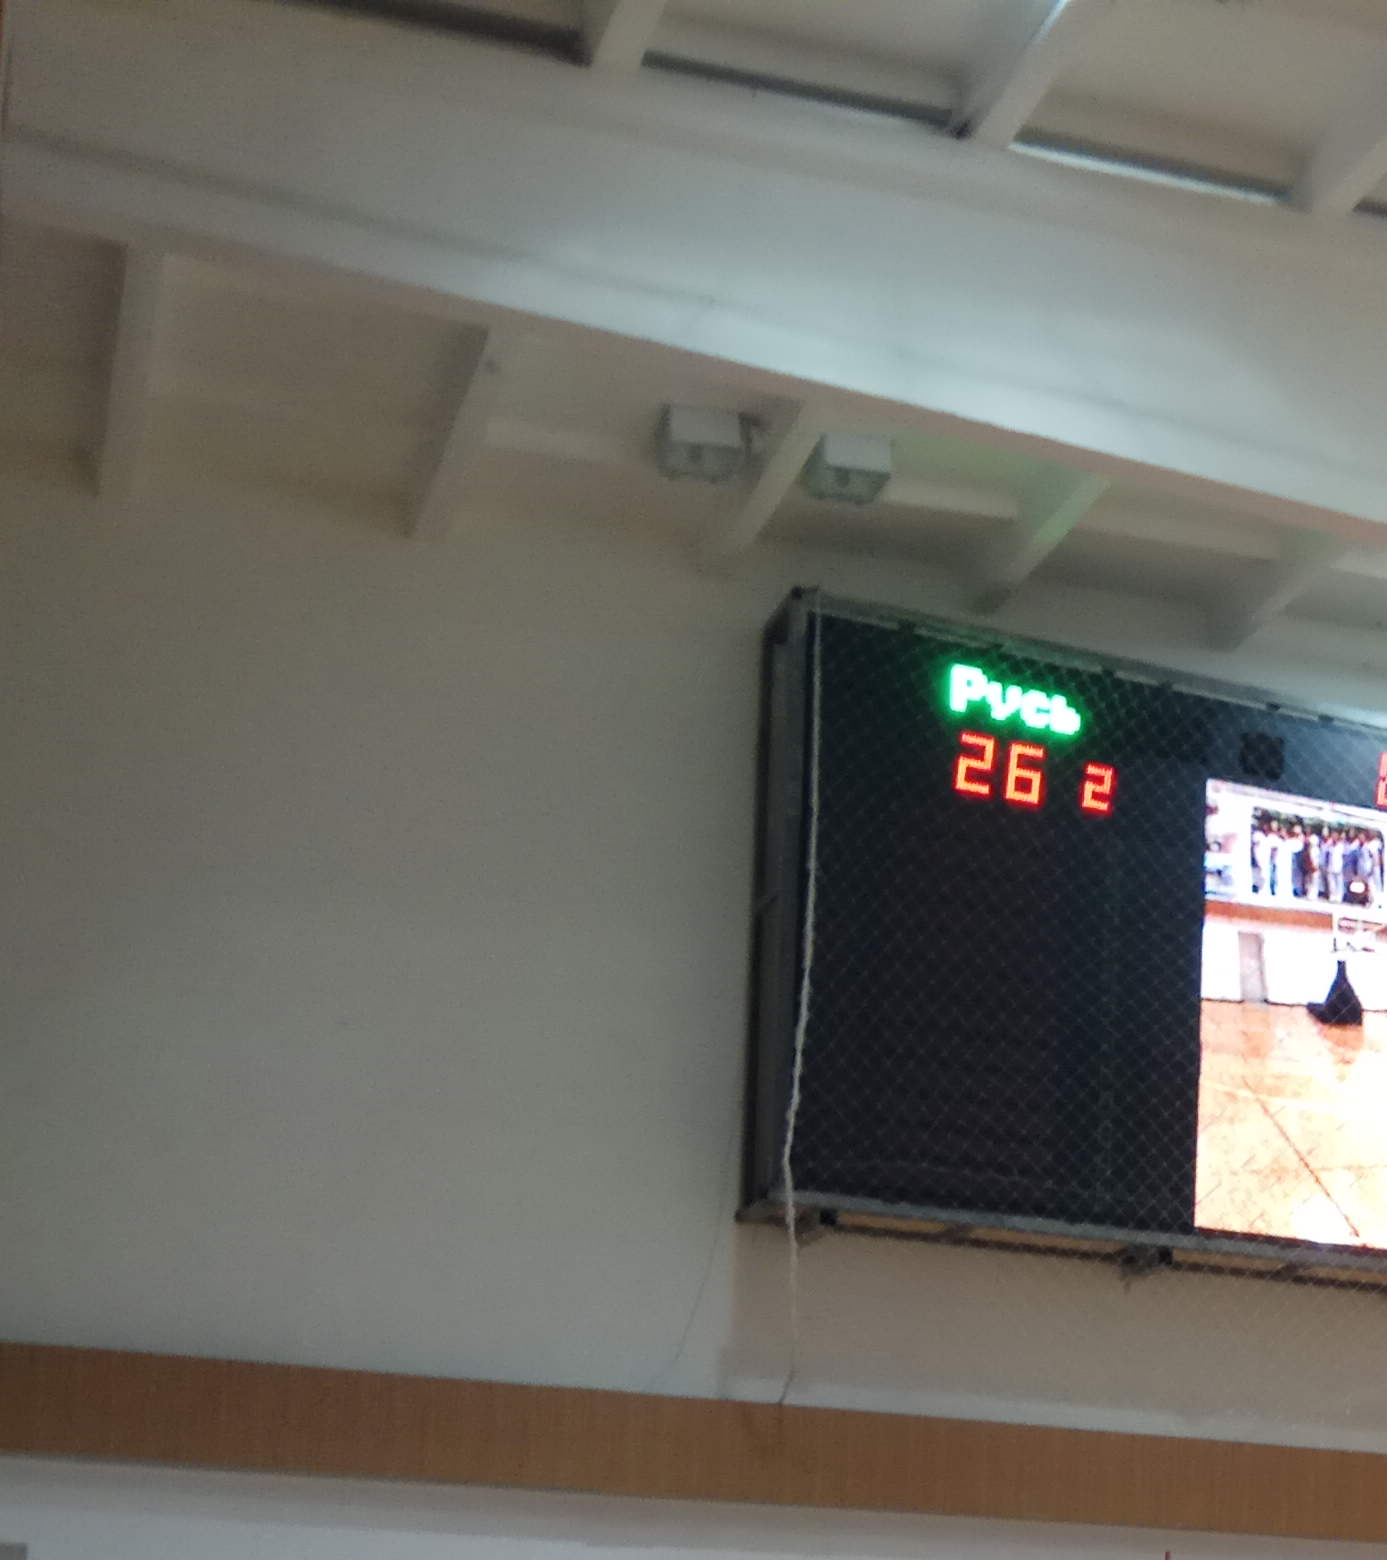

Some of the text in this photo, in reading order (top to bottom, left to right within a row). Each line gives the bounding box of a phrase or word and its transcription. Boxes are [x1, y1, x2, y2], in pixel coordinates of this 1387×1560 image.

[949, 662, 1082, 736] Русь
[954, 731, 1045, 805] 26
[1081, 761, 1115, 812] 2
